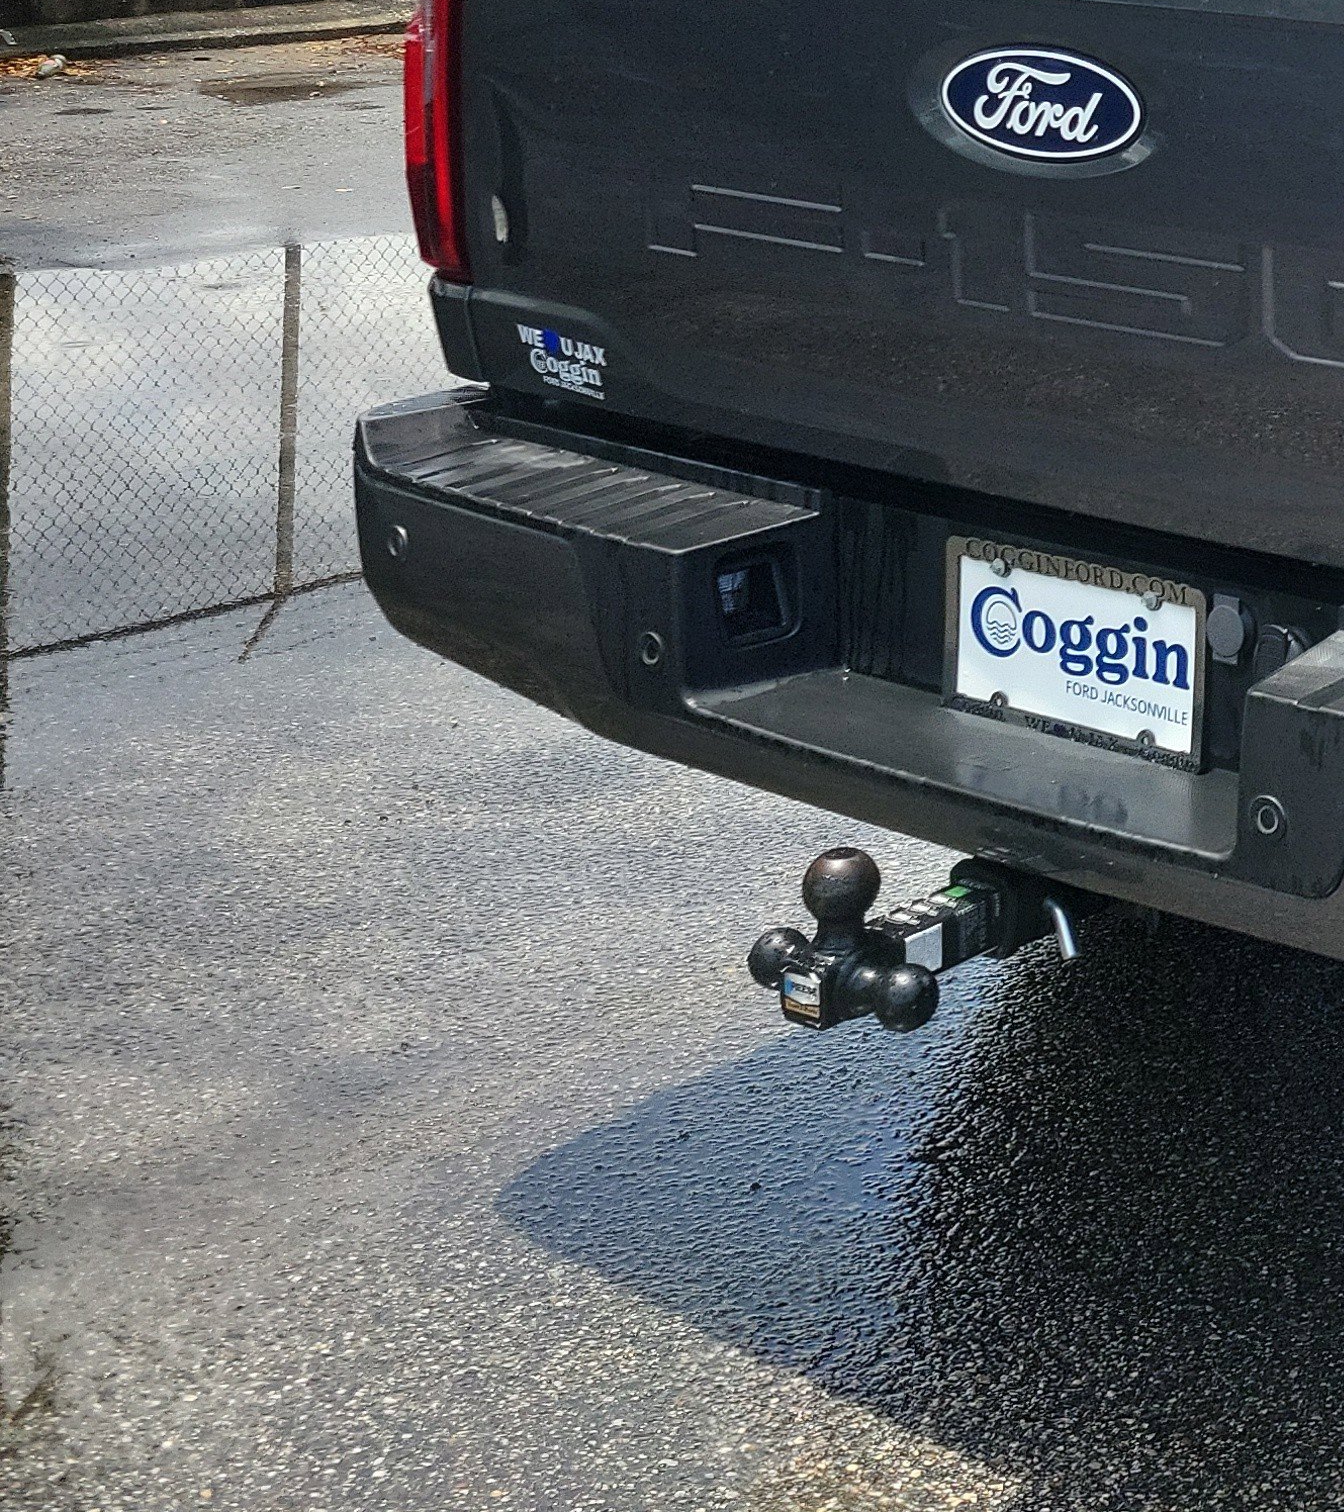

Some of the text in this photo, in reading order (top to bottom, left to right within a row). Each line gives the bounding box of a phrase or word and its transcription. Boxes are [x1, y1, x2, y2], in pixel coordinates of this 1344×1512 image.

[973, 61, 1104, 144] Ford
[516, 323, 608, 367] WE U JAX
[530, 348, 604, 387] Coggin
[970, 585, 1190, 690] Coggin
[1066, 680, 1189, 726] FORD JACKSONVILLE
